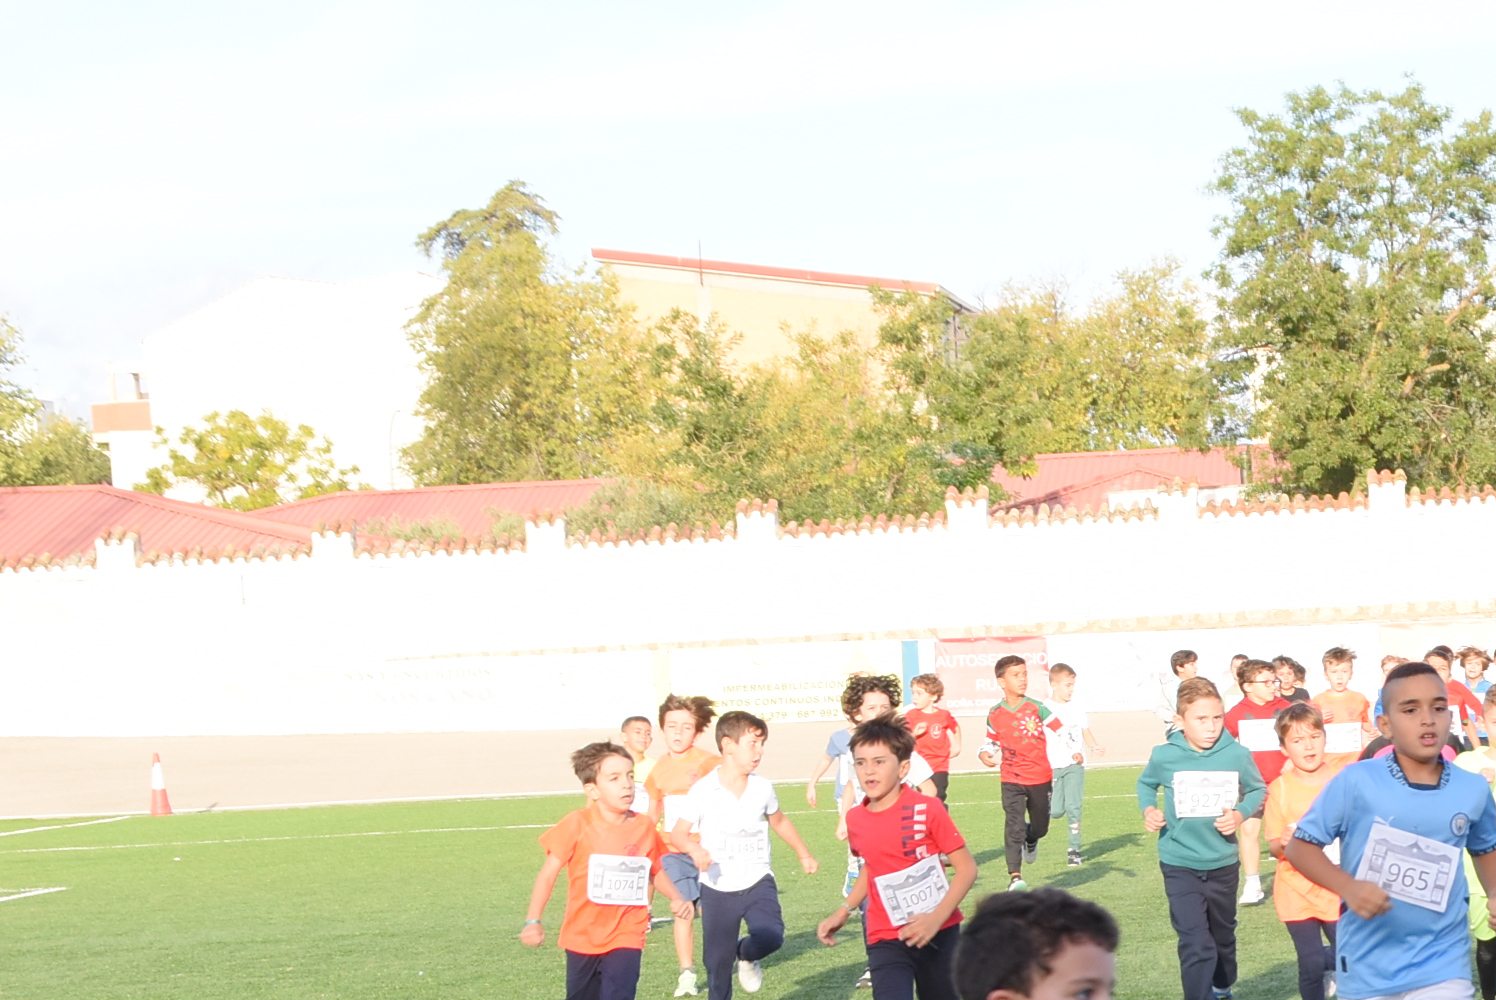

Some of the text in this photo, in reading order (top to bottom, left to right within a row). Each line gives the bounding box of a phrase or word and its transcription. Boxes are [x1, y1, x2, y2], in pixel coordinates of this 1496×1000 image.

[714, 699, 751, 708] ENTOS
[1190, 792, 1222, 808] 927
[606, 878, 635, 892] 1074
[1385, 862, 1432, 892] 965
[901, 884, 935, 909] 1007
